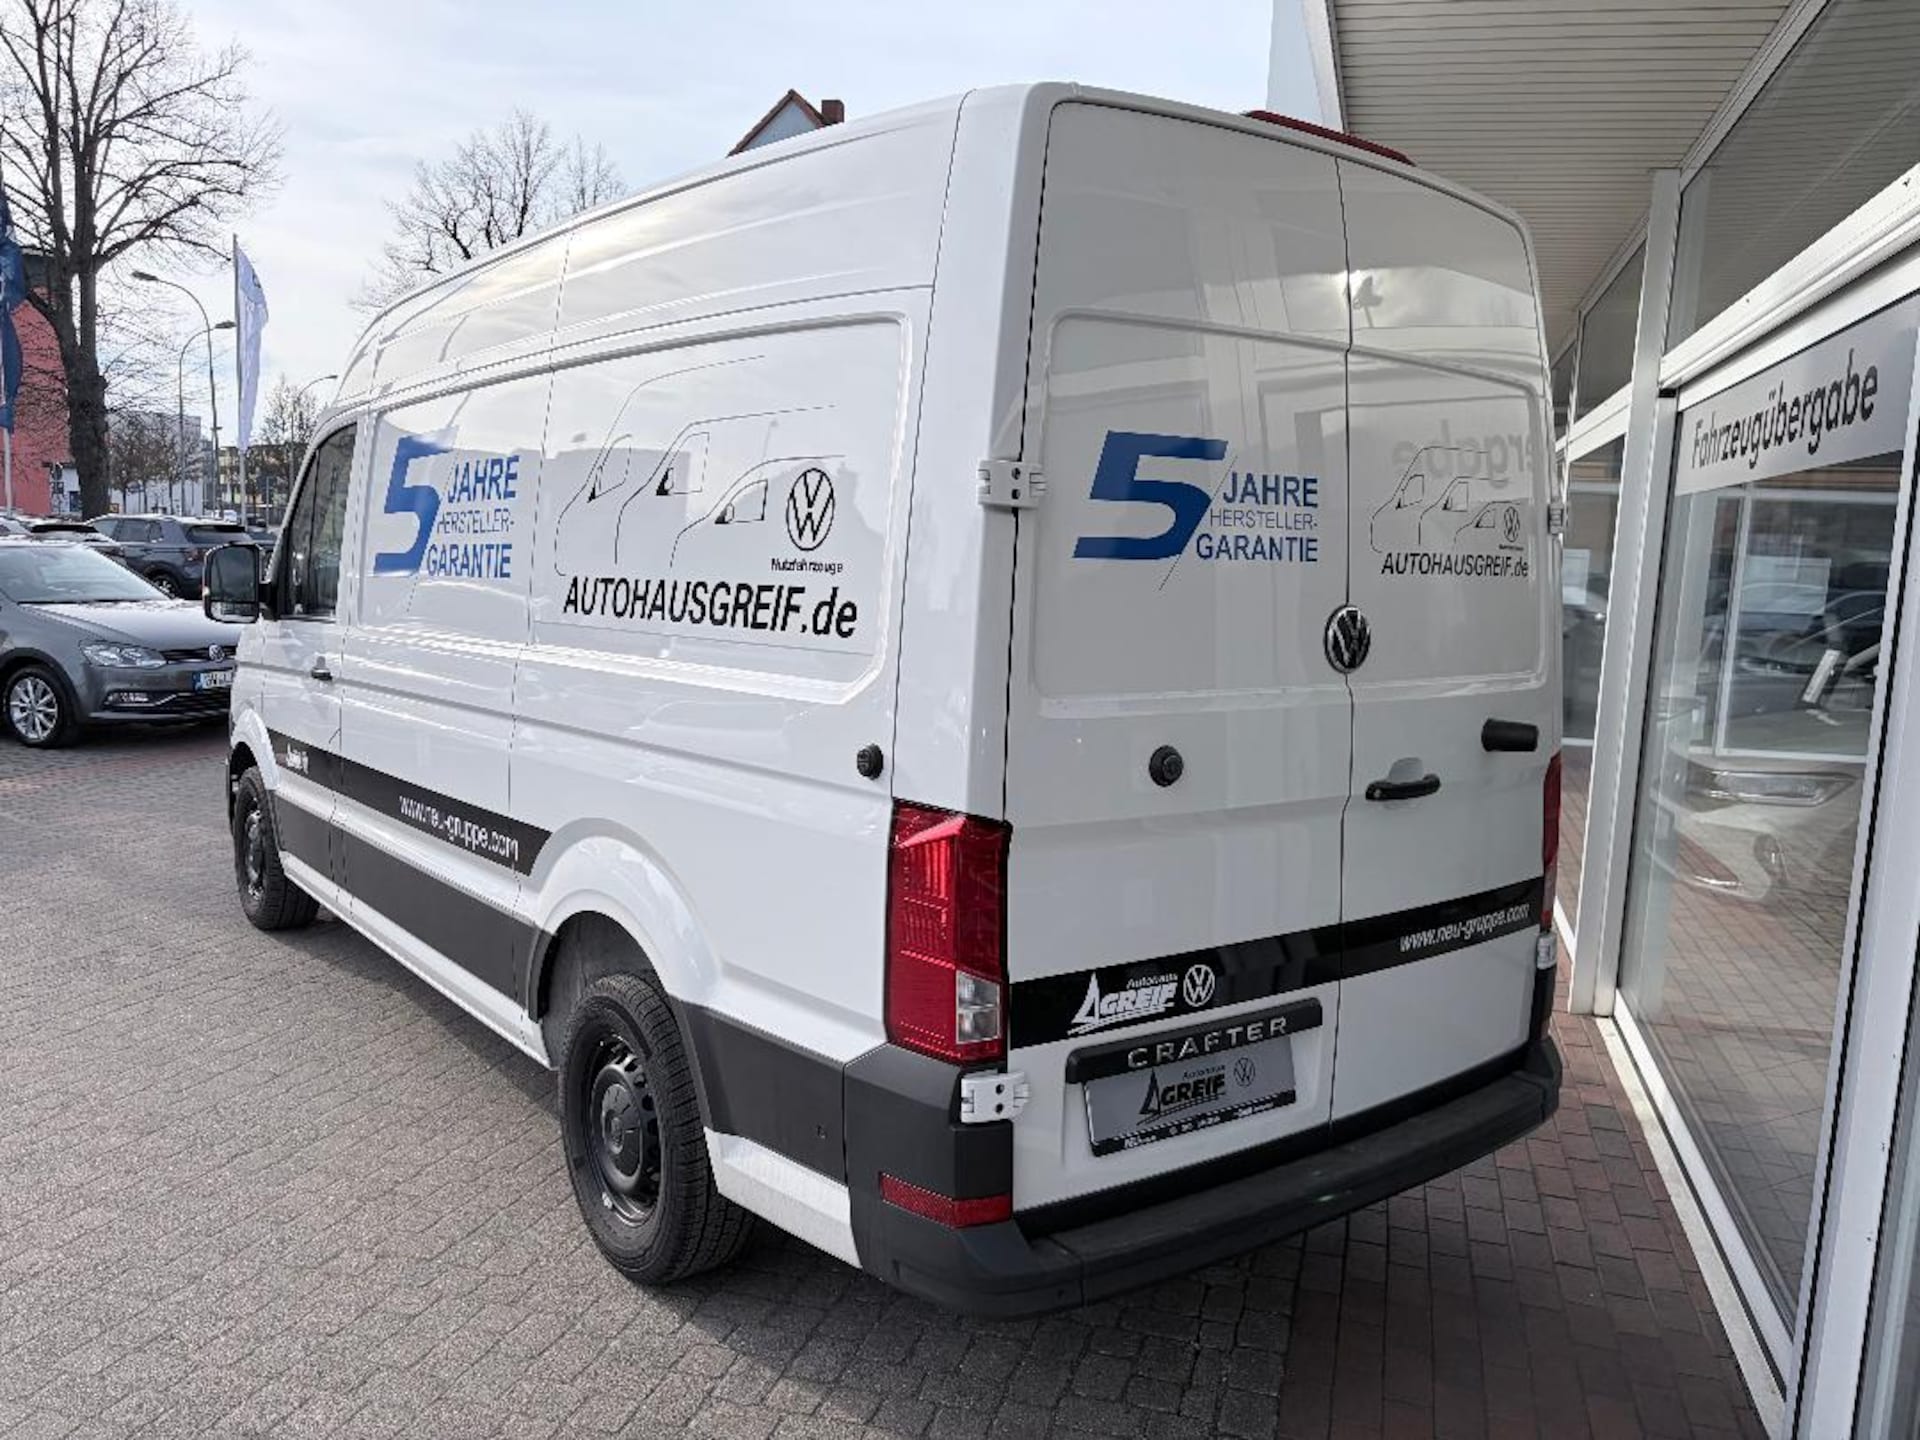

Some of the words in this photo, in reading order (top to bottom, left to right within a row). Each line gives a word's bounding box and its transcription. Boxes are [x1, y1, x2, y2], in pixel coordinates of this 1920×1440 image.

[1691, 349, 1878, 469] Fahrzeugübergabe
[447, 455, 520, 501] JAHRE
[1073, 430, 1229, 560] 5
[1223, 472, 1318, 508] JAHRE
[374, 431, 455, 577] 5
[436, 507, 515, 535] HERSTELLER-
[1209, 508, 1318, 531] HERSTELLER-
[427, 543, 512, 579] GARANTIE
[1196, 534, 1318, 563] GARANTIE
[1381, 552, 1529, 577] AUTOHAUSGREIF.de
[564, 576, 857, 638] AUTOHAUSGREIF.de
[1400, 903, 1530, 952] www.neu-gruppe.com
[1100, 982, 1178, 1016] GREIF
[1127, 1016, 1287, 1069] CRAFTER
[1161, 1074, 1225, 1105] GREIF
